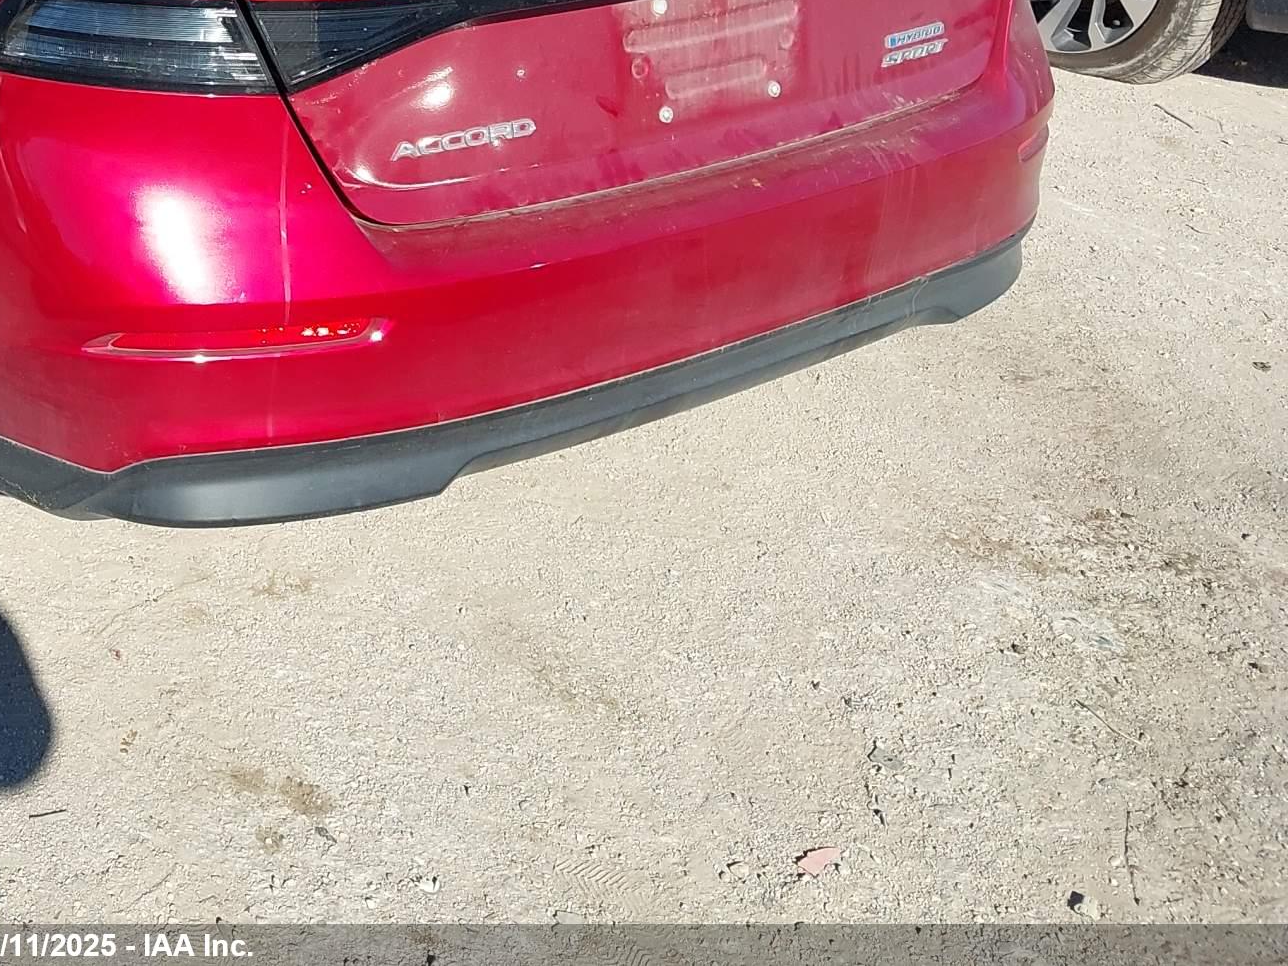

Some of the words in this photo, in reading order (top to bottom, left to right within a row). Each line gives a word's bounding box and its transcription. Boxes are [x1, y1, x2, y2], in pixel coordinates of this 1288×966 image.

[893, 22, 943, 46] HYBRID
[881, 38, 948, 67] SPORT
[390, 118, 537, 162] ACCORD
